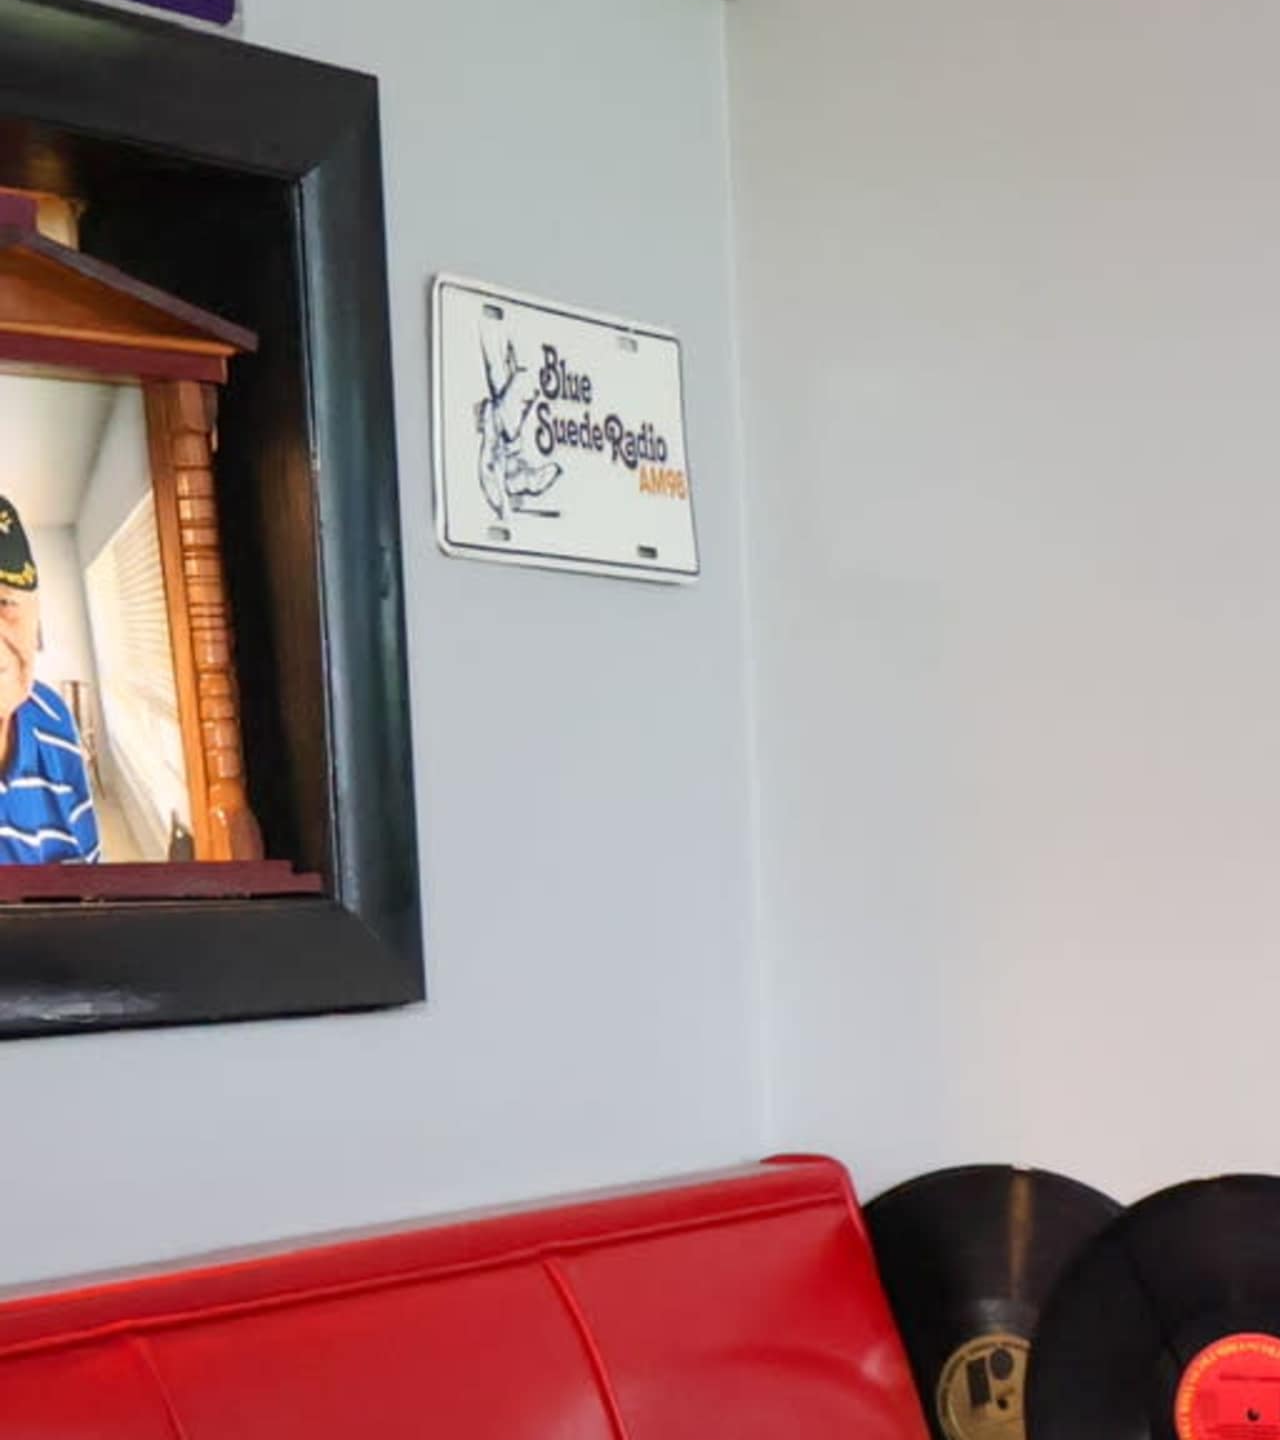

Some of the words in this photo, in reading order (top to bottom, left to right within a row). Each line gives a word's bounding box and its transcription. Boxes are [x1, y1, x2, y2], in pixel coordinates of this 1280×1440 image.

[539, 343, 593, 405] Blue
[534, 402, 602, 456] Suede
[603, 414, 668, 470] Radio
